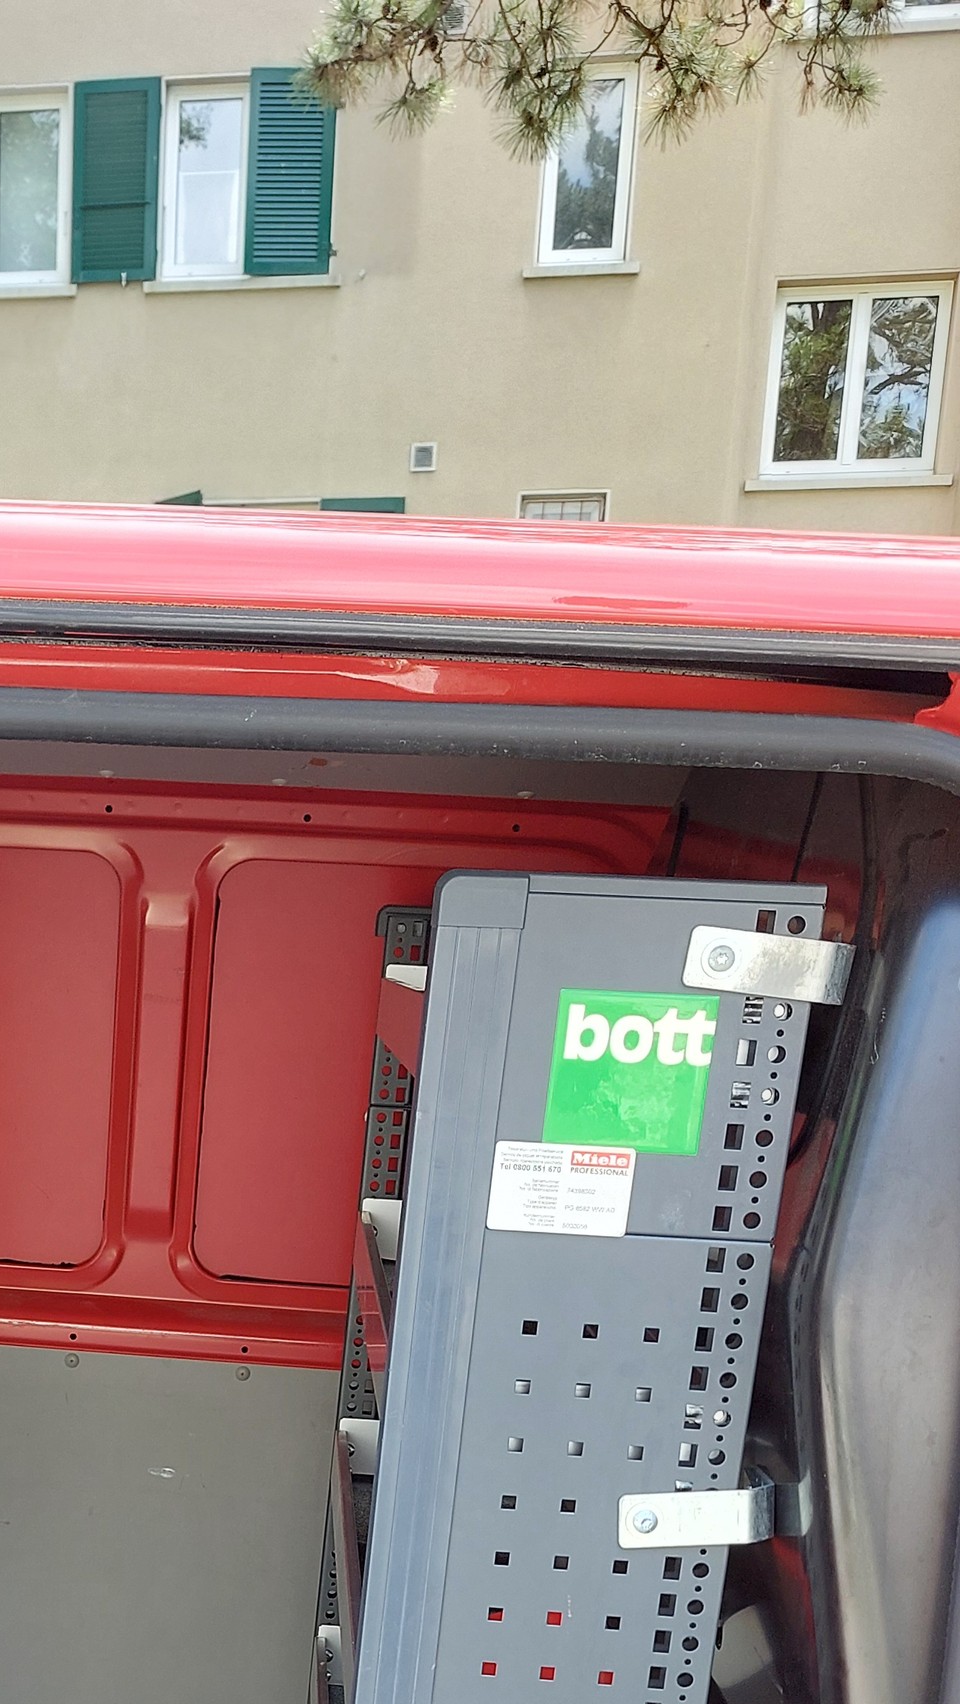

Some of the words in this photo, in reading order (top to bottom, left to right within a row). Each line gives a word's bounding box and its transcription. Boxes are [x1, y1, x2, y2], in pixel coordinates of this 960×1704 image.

[563, 1003, 717, 1067] bott
[572, 1152, 629, 1167] Miele
[513, 1163, 531, 1172] 0800
[570, 1166, 629, 1177] PROFESSIONAL
